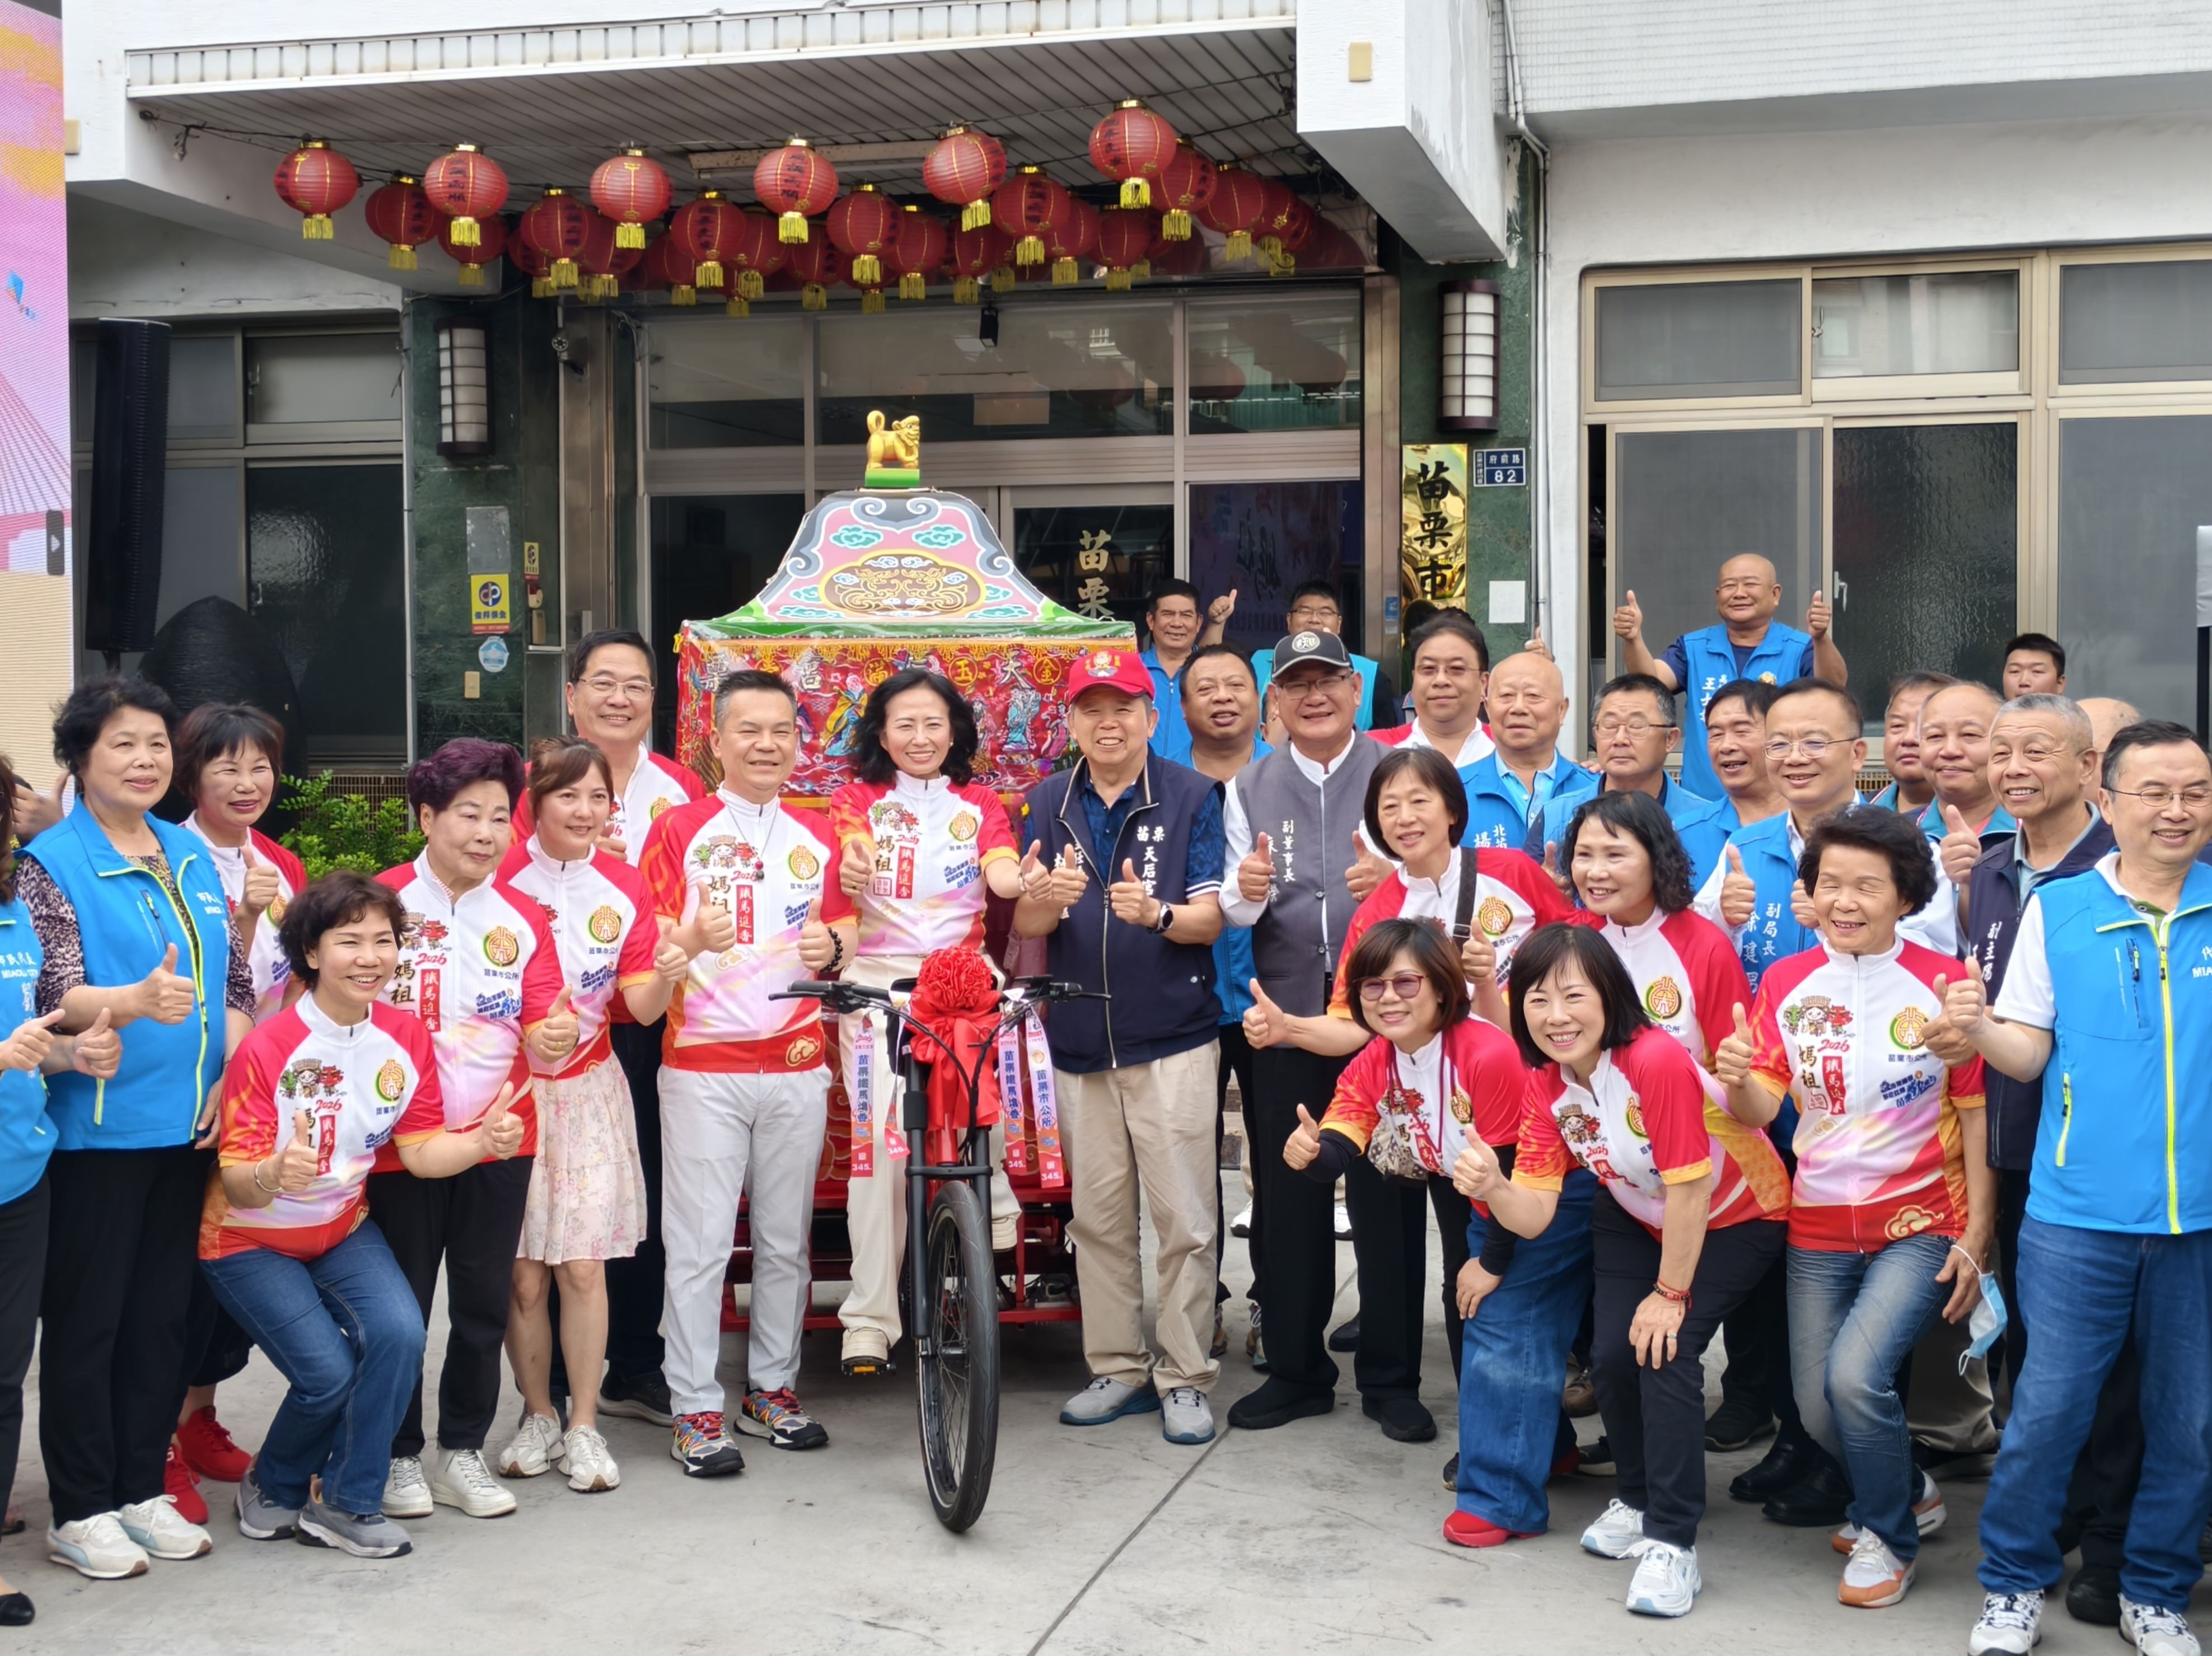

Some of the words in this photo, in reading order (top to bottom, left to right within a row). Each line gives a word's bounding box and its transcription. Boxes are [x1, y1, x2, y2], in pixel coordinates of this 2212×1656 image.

[1489, 453, 1520, 464] 府前路
[1494, 469, 1517, 483] 82
[1413, 461, 1453, 600] 苗栗市
[1078, 529, 1115, 619] 苗栗
[874, 834, 895, 872] 媽祖
[1137, 825, 1166, 842] 苗栗
[1282, 819, 1296, 883] 副董事長
[1142, 846, 1159, 896] 天后宮
[1762, 902, 1781, 956] 副局長
[390, 959, 415, 1005] 媽祖
[1798, 1045, 1820, 1089] 媽祖
[1817, 1039, 1850, 1052] 2026
[1035, 1069, 1051, 1127] 苗栗市公所
